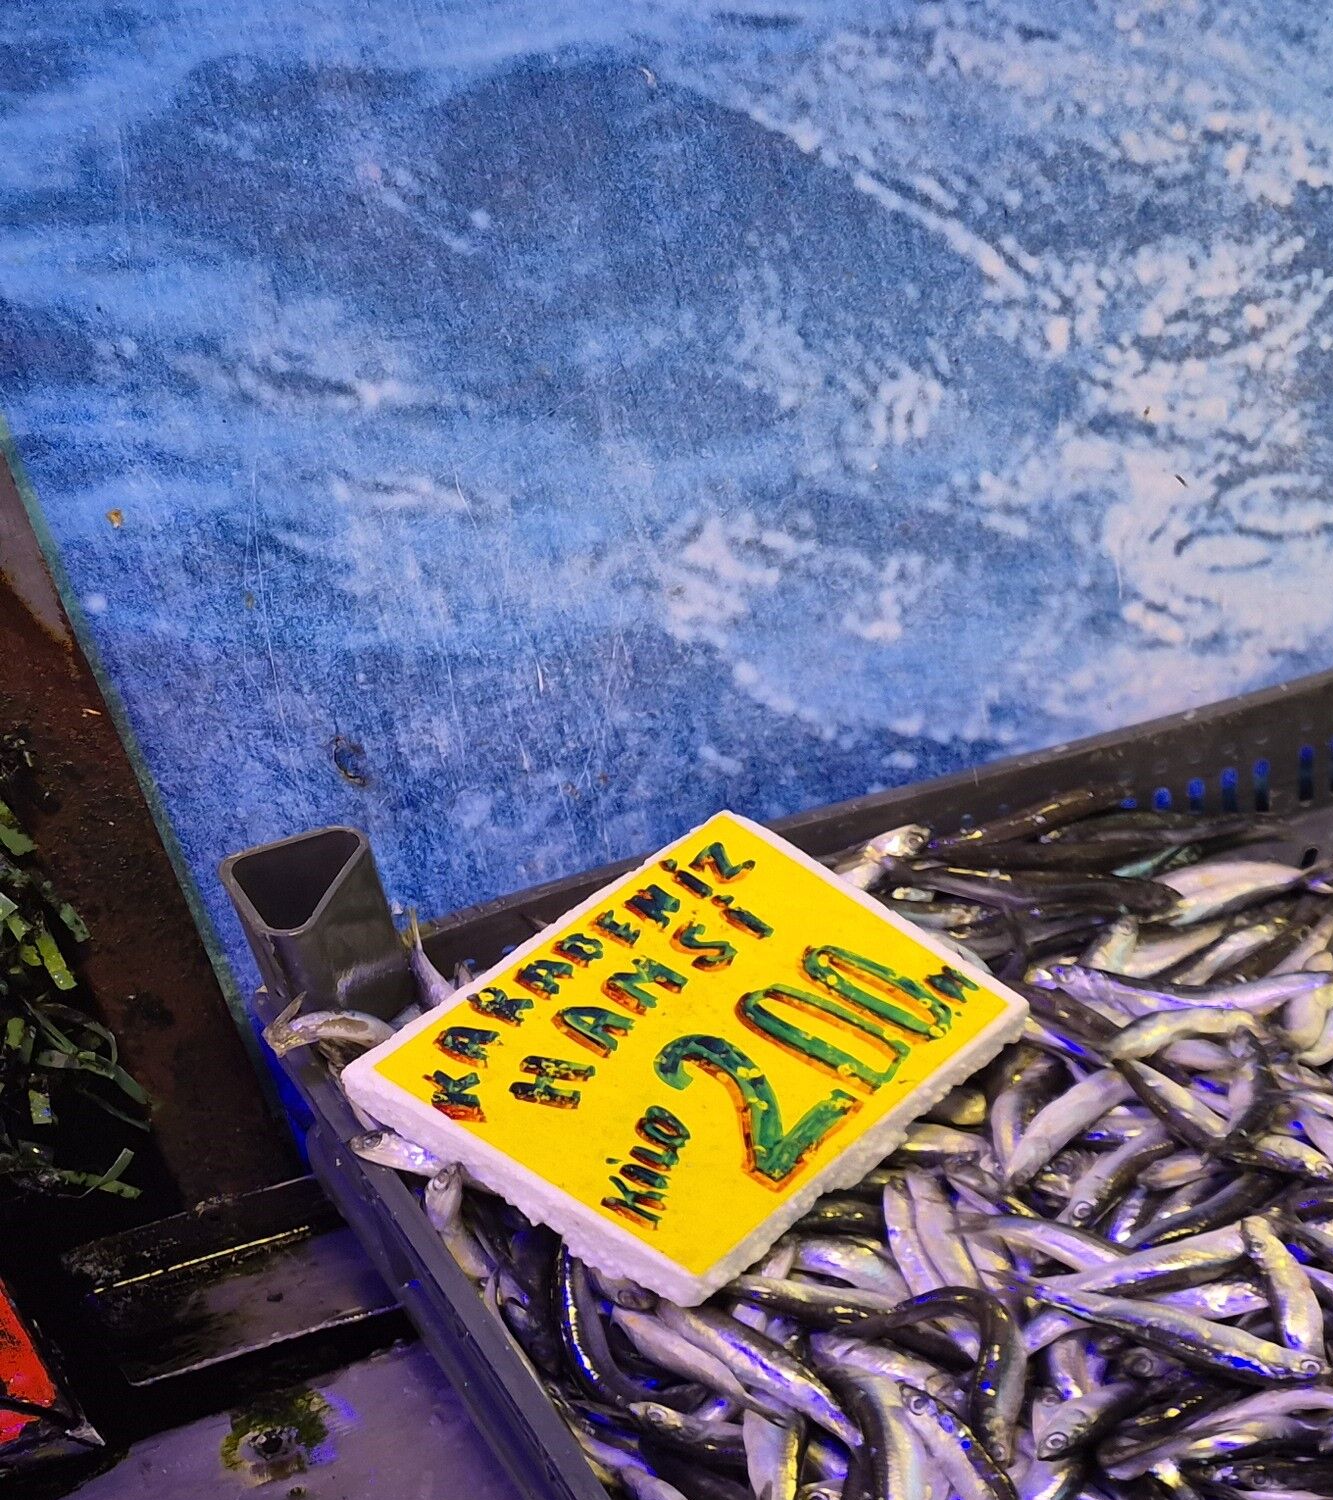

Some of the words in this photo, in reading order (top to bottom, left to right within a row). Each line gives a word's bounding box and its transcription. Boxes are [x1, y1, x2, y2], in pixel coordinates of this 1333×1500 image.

[424, 841, 756, 1123] KARADENİZ
[509, 893, 774, 1110] HAMSİ
[600, 1104, 691, 1231] KİLO
[653, 944, 953, 1194] 200
